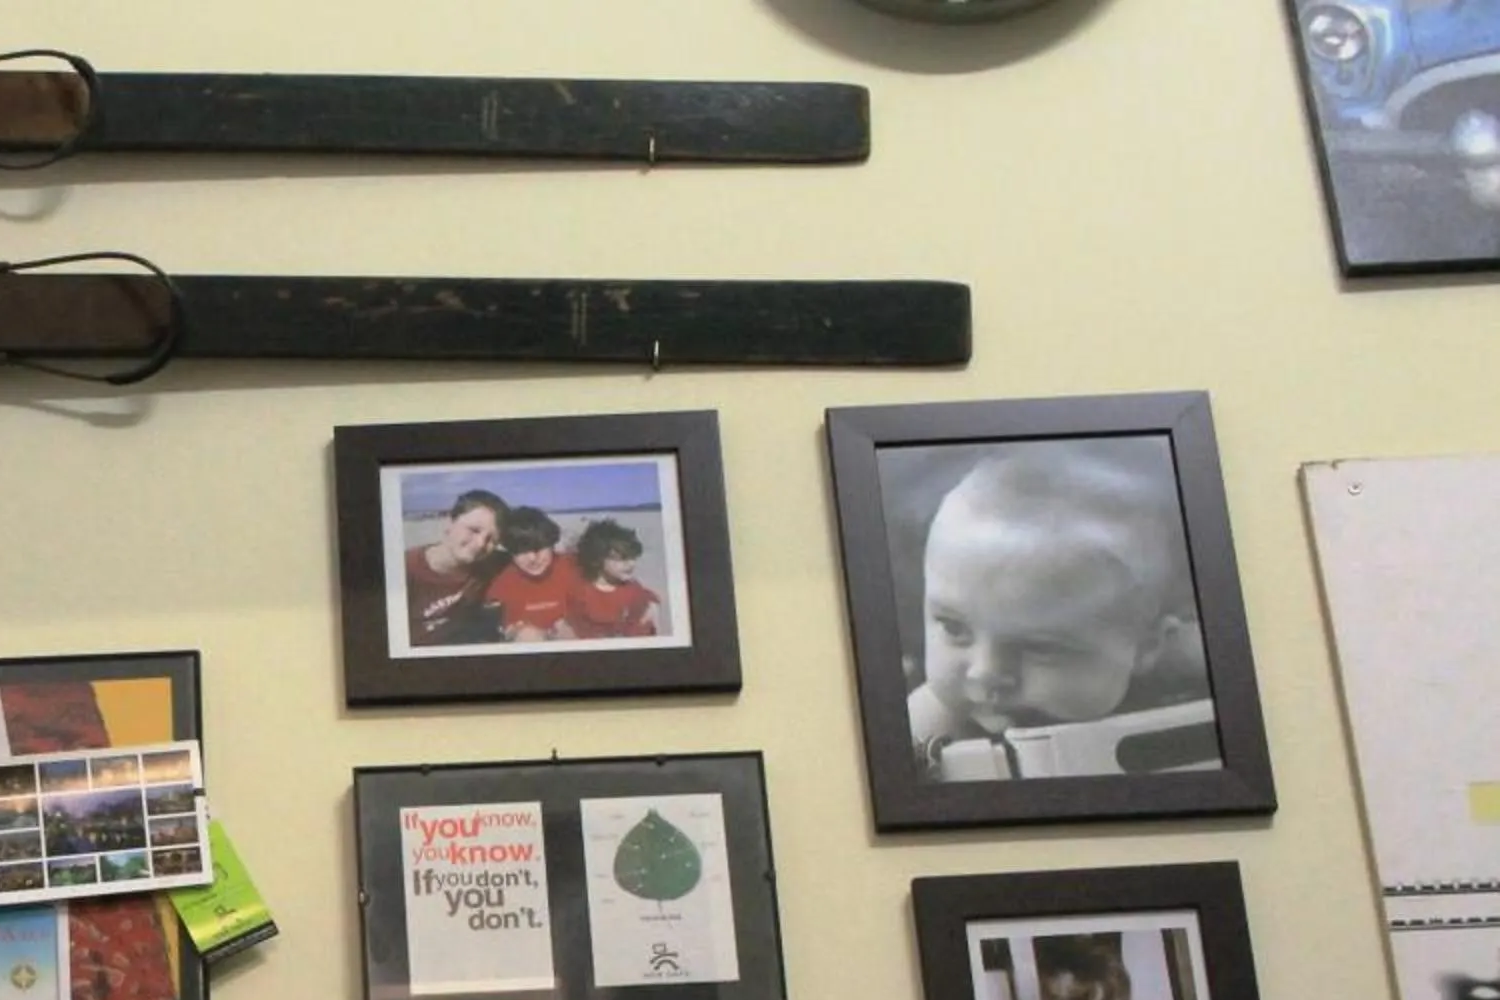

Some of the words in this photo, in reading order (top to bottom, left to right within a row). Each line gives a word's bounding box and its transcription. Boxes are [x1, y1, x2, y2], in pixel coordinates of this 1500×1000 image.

[404, 812, 419, 831] If
[419, 815, 481, 846] you
[412, 847, 451, 866] you
[412, 868, 434, 896] If
[433, 870, 474, 891] you
[444, 887, 505, 917] you
[467, 906, 543, 931] don't.
